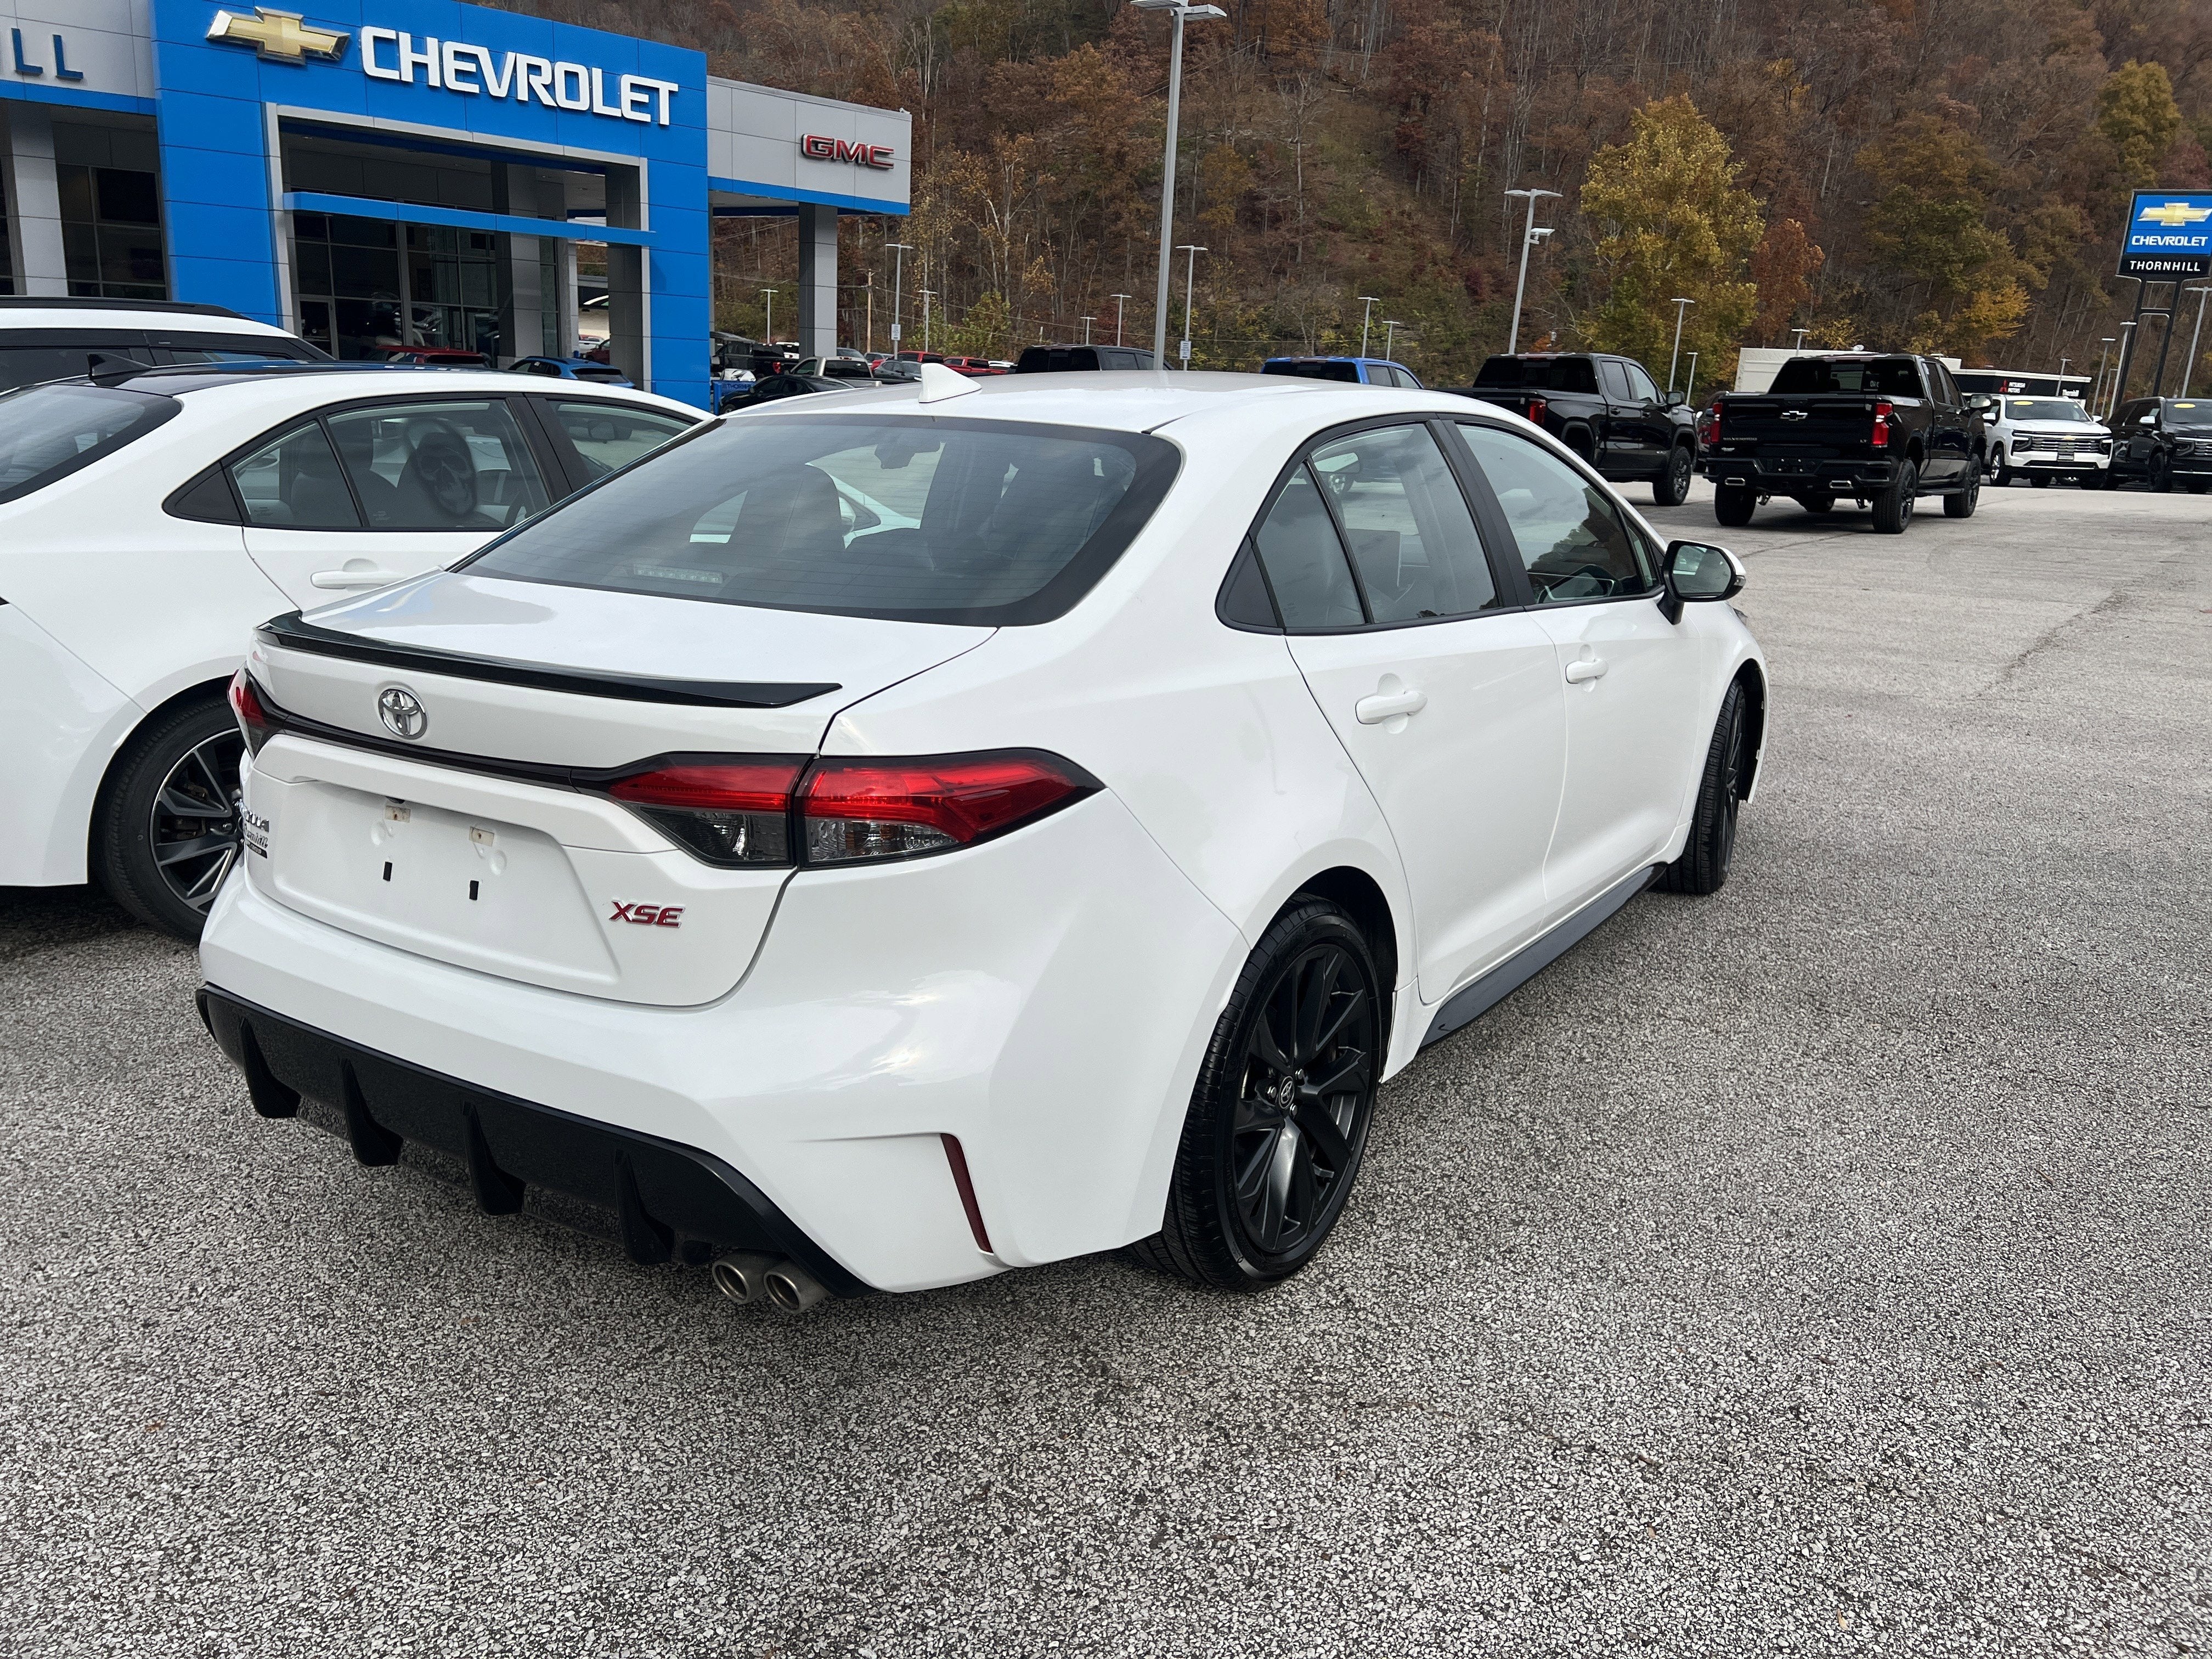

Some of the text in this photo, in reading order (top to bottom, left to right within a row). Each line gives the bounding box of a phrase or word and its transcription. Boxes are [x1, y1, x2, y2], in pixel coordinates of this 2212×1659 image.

[360, 25, 679, 127] CHEVROLET
[802, 133, 895, 170] GMC
[2131, 235, 2209, 247] CHEVROLET
[2129, 260, 2201, 272] THORNHILL
[608, 898, 686, 929] XSE
